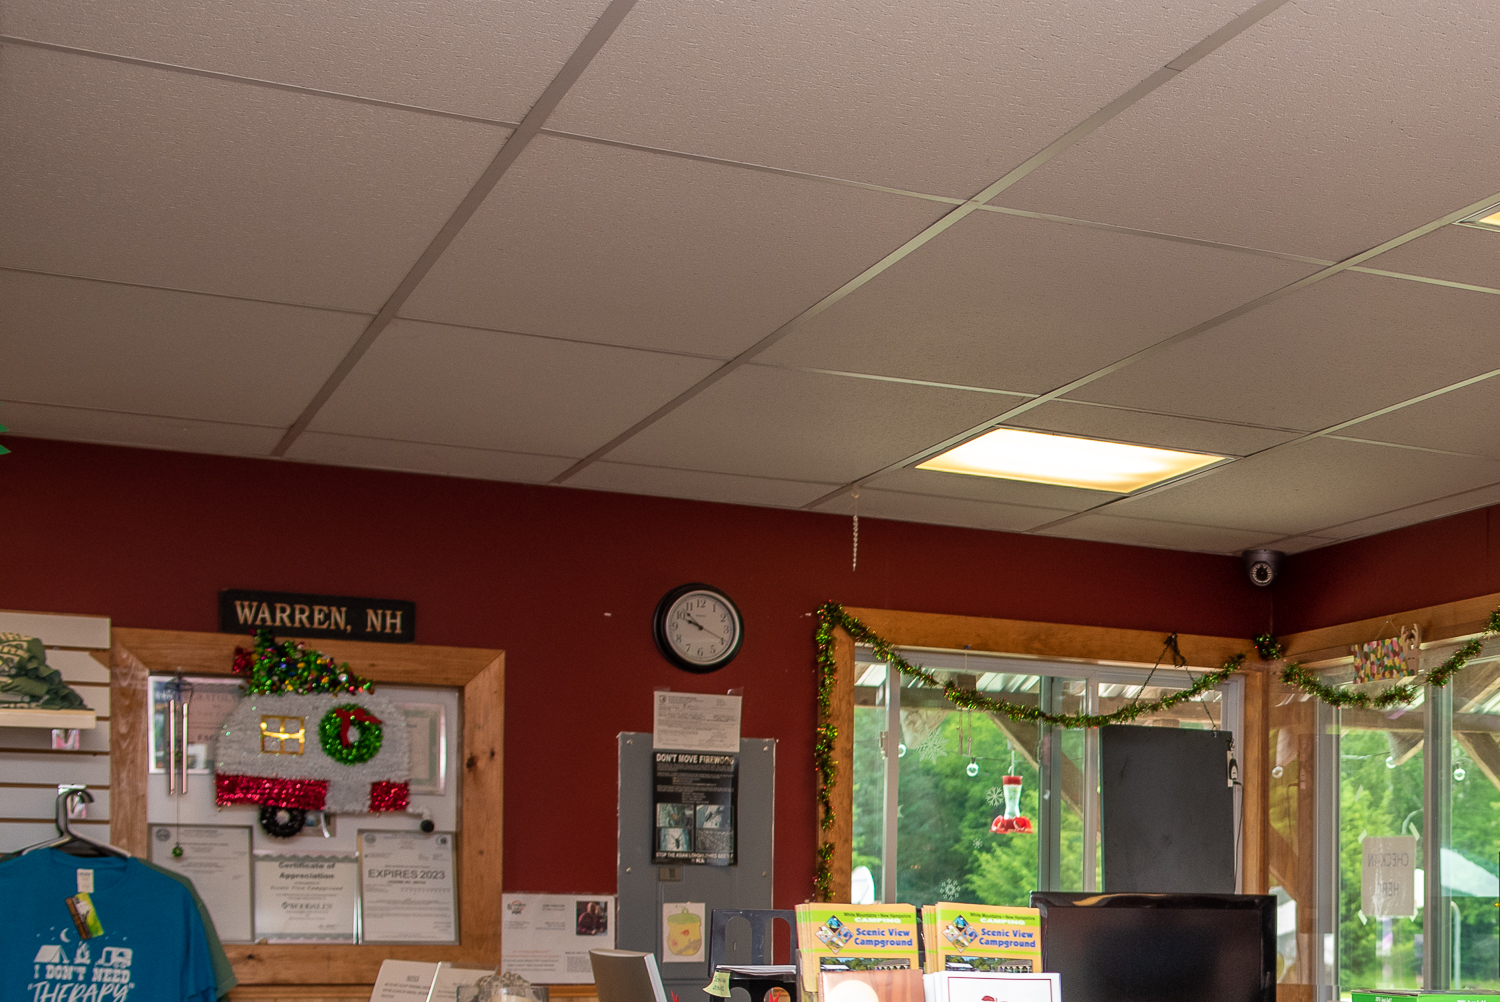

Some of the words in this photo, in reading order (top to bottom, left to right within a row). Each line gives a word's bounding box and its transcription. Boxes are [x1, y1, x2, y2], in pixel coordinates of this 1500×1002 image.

[234, 600, 352, 633] WARREN,
[365, 608, 403, 634] NH
[656, 754, 678, 763] DON'T
[678, 754, 698, 764] MOVE
[368, 869, 418, 880] EXPIRES
[420, 870, 446, 880] 2023
[856, 928, 886, 937] Scenic
[888, 928, 910, 937] View
[981, 928, 1010, 938] Scenic
[1012, 930, 1034, 938] View
[854, 938, 913, 948] Campground
[978, 938, 1036, 948] Campground
[34, 964, 40, 979] I
[45, 965, 87, 981] DON'T
[92, 968, 131, 983] NEED
